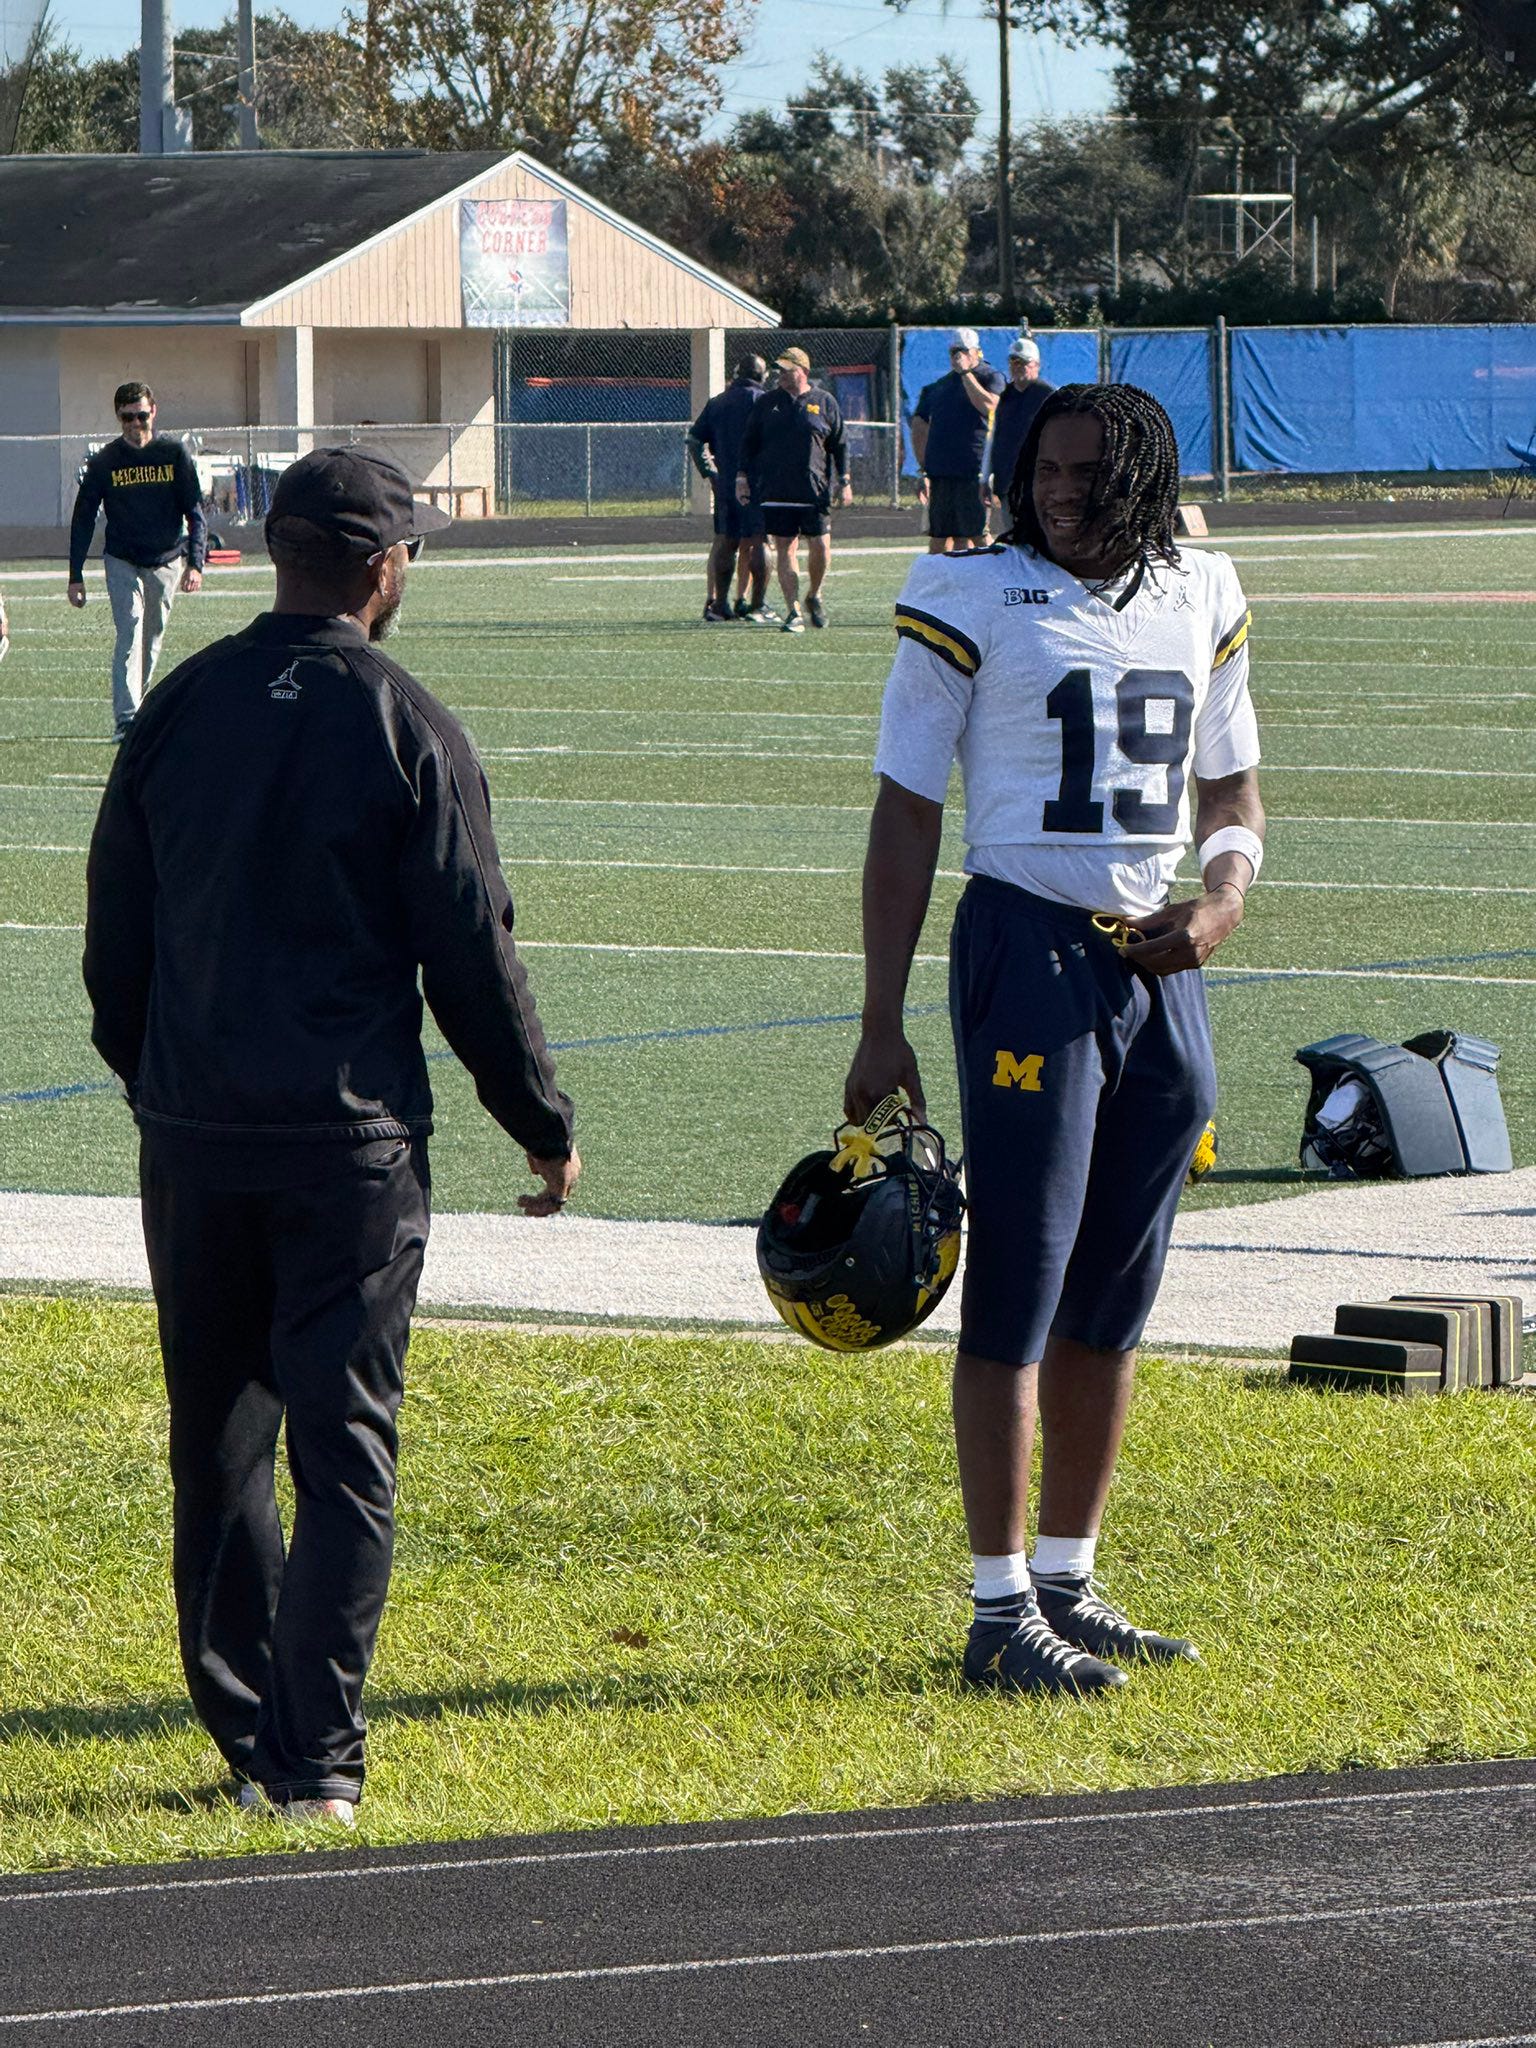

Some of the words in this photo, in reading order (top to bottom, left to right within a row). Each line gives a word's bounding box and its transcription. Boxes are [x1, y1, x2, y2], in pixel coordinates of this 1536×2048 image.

[481, 229, 547, 254] CORNER
[111, 464, 174, 487] MICHIGAN
[1042, 669, 1195, 834] 19
[992, 1050, 1044, 1091] M
